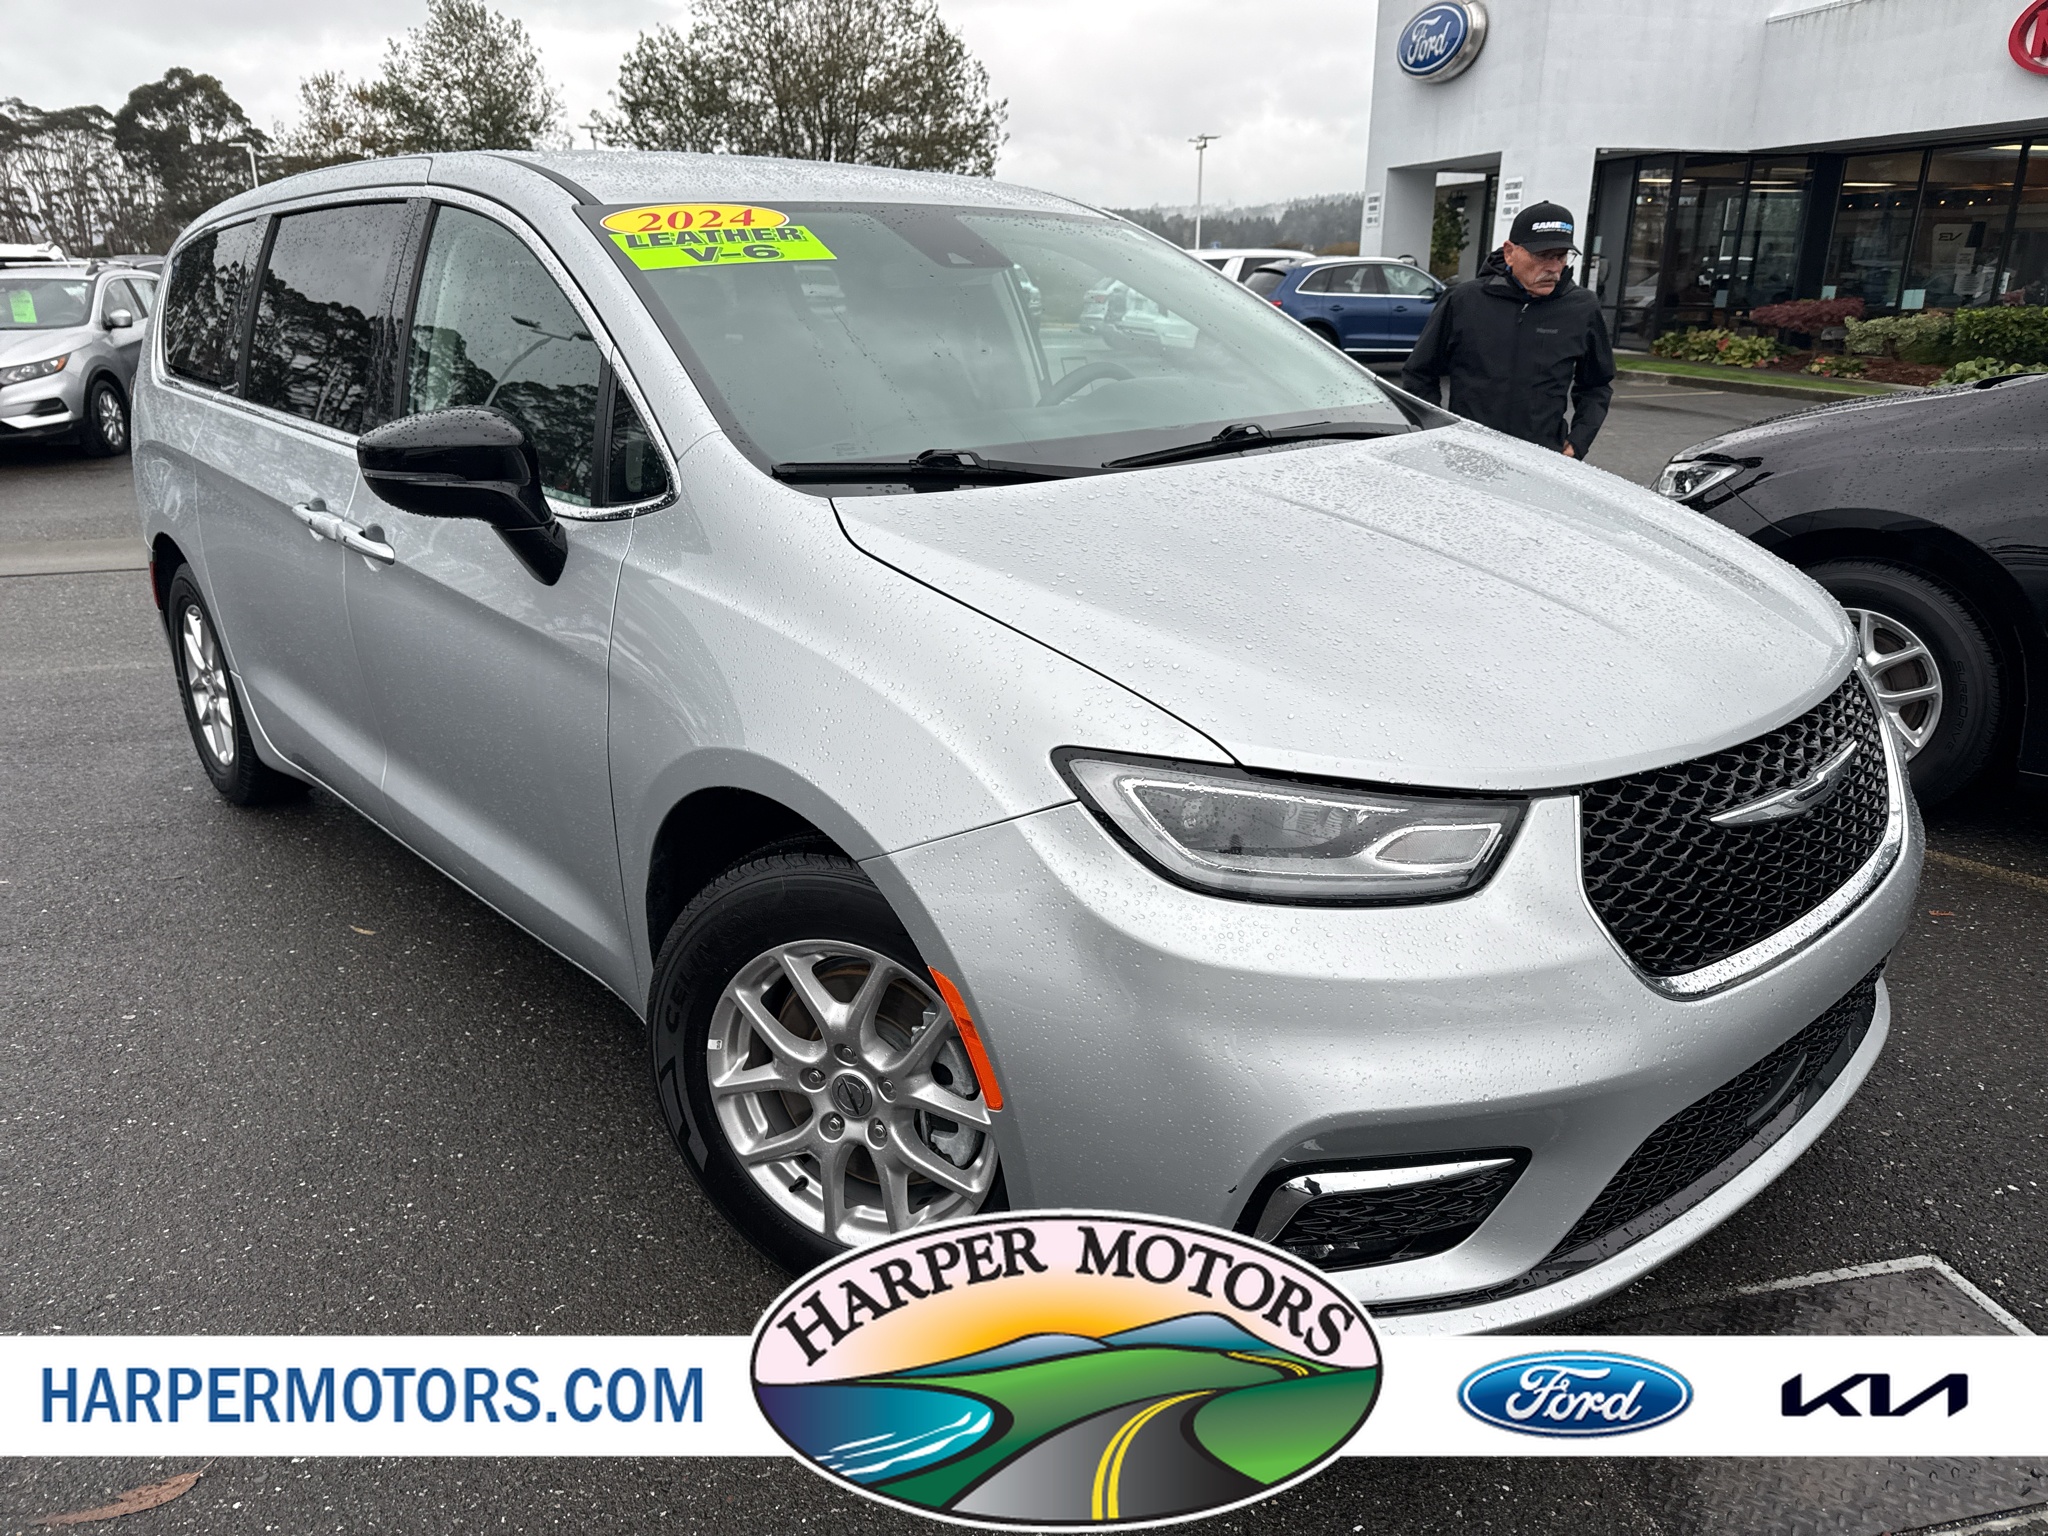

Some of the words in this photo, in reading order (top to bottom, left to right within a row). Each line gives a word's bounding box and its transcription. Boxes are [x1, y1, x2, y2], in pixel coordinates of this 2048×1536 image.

[1406, 14, 1452, 65] Ford
[637, 208, 756, 233] 2024
[624, 226, 806, 249] LEATHER
[679, 244, 783, 263] V-6
[1944, 660, 1969, 753] SUREDRIVE
